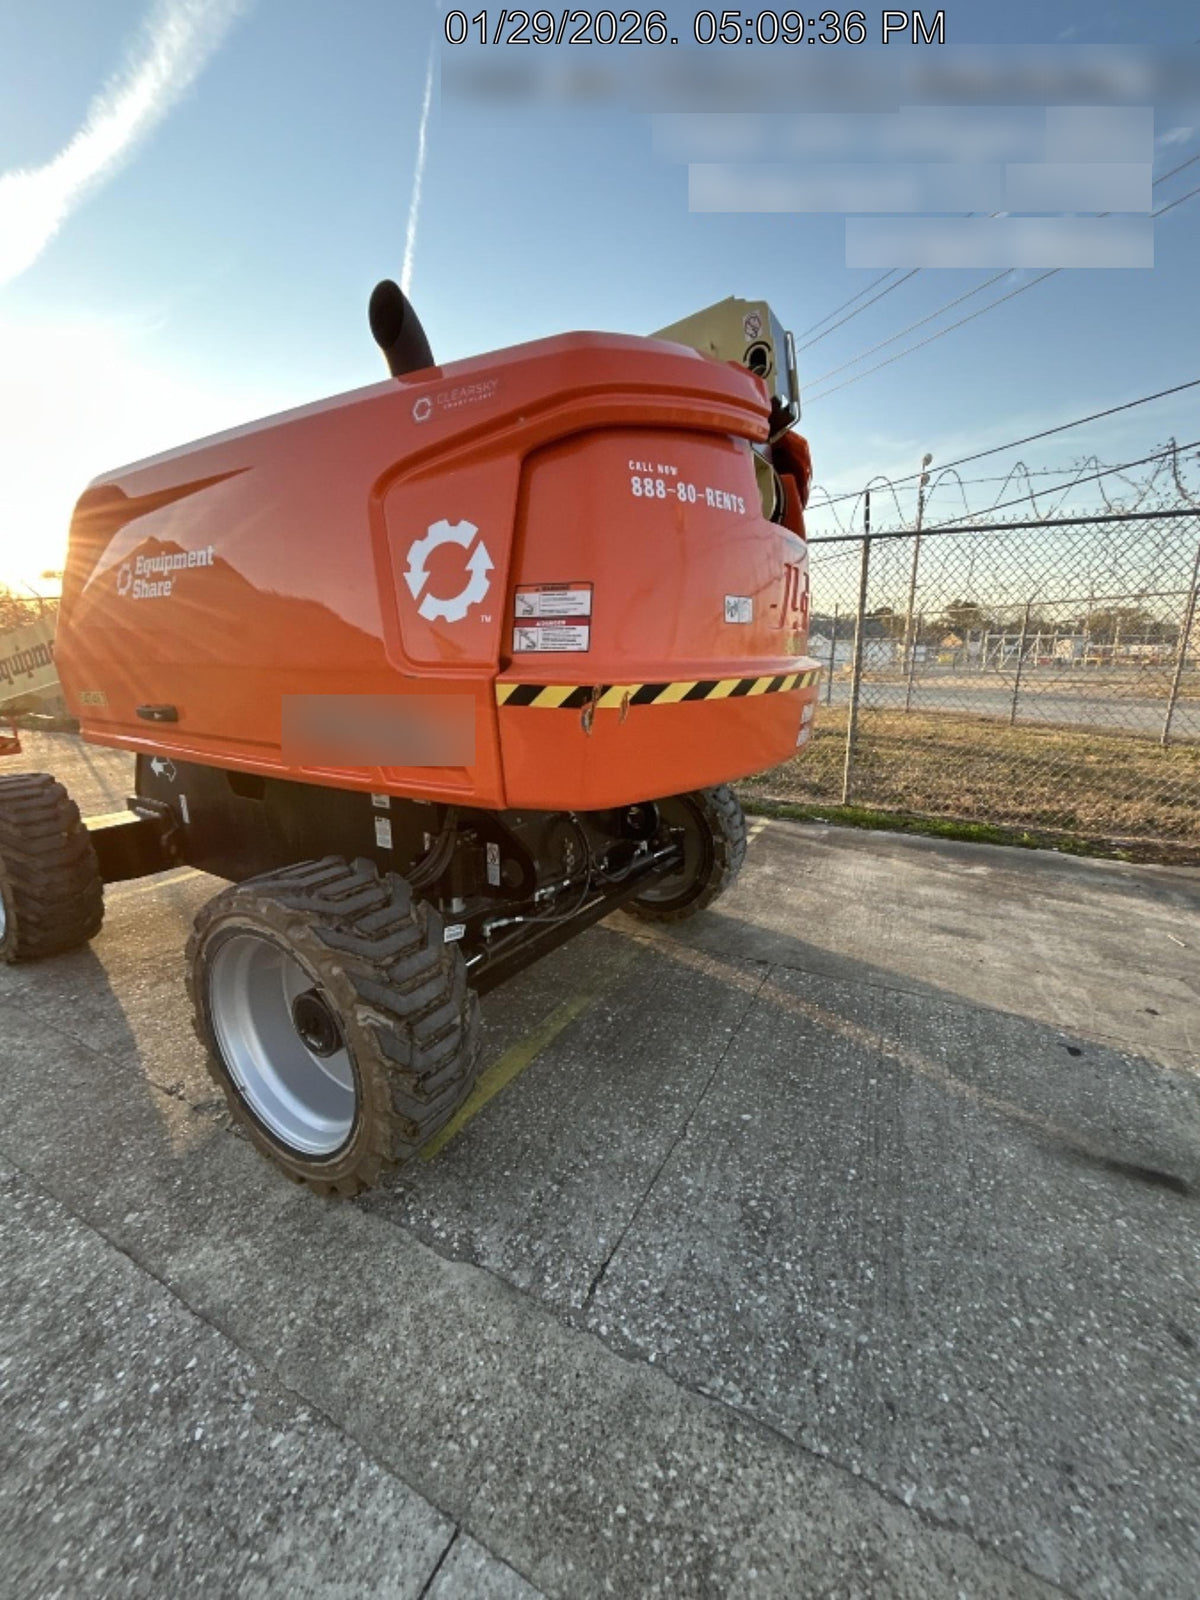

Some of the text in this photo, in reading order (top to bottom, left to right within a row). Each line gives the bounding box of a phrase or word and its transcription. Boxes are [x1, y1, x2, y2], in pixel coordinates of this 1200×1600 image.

[628, 459, 678, 476] CALL NOW
[631, 476, 746, 514] 888-80-RENTS
[134, 545, 216, 579] Equipment
[132, 579, 173, 599] Share
